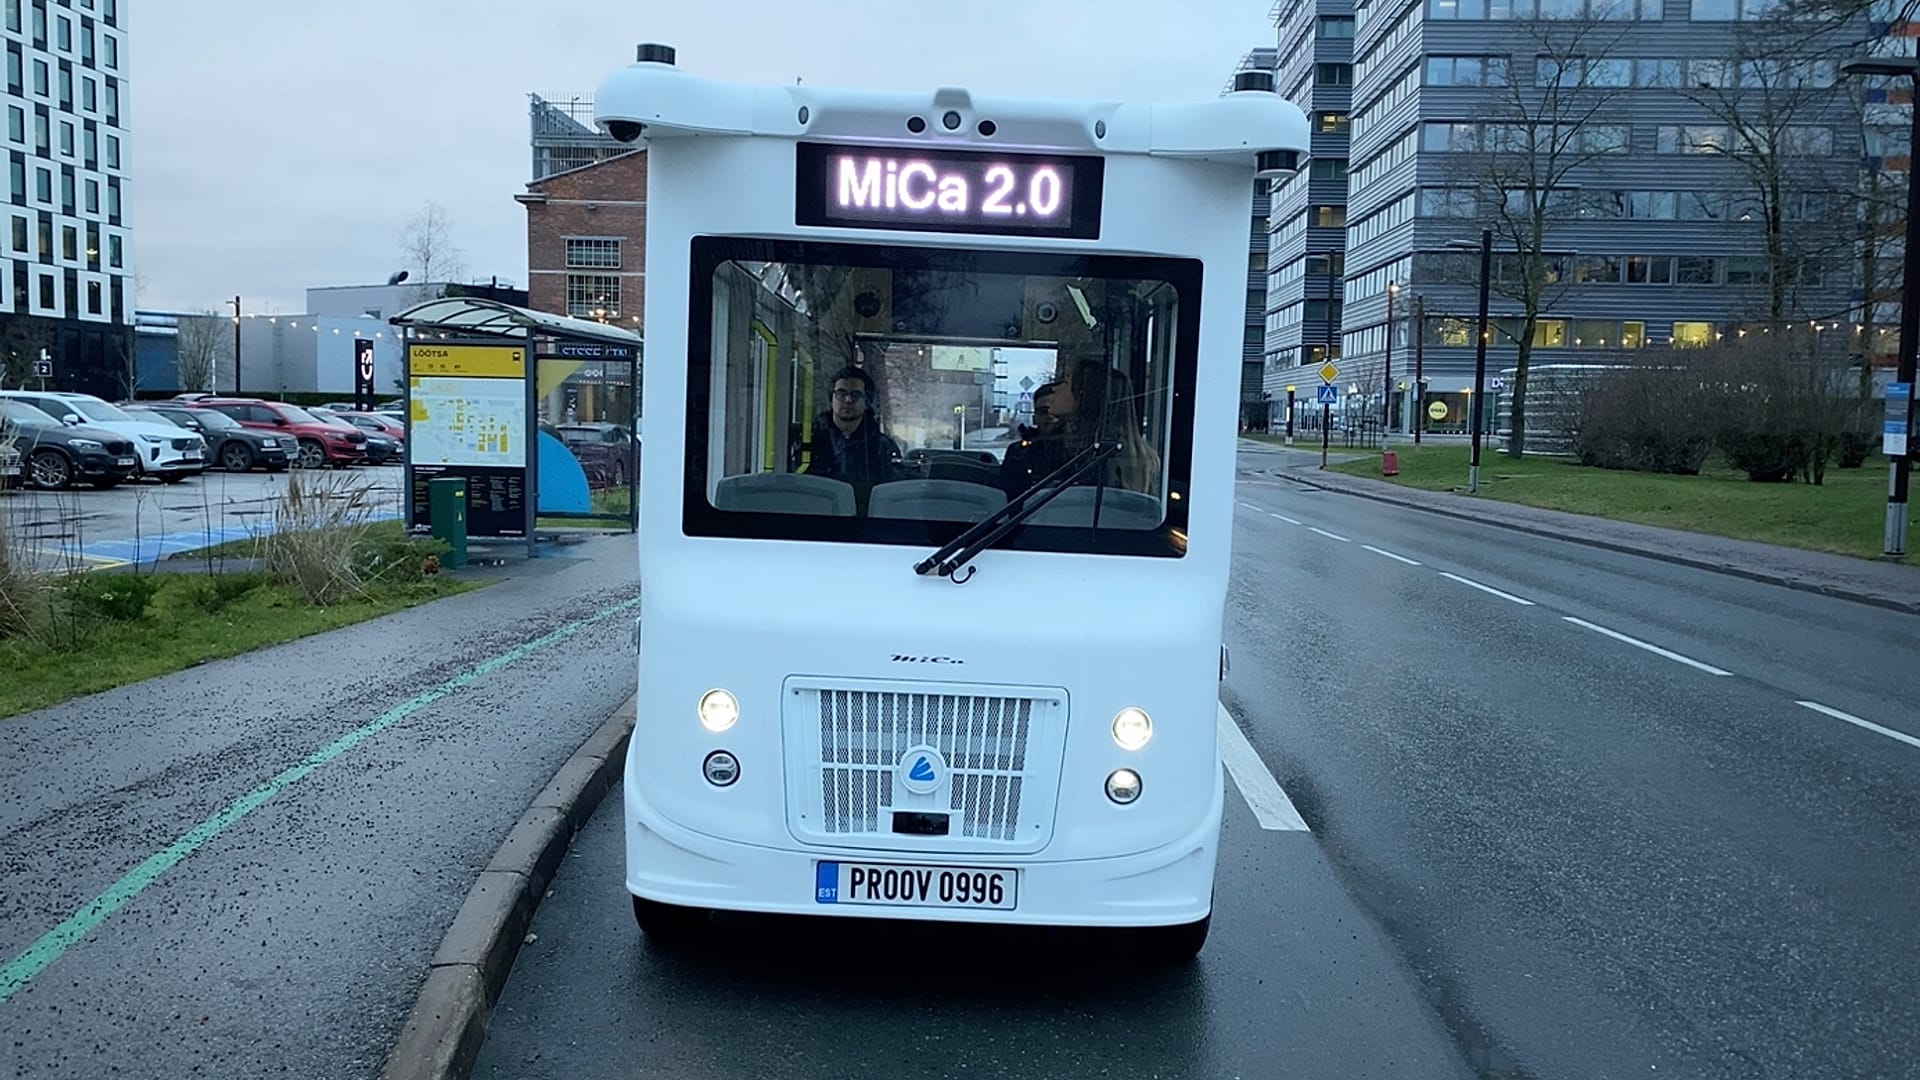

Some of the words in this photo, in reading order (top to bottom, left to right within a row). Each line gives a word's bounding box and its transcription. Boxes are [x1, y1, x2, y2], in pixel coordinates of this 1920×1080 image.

[838, 157, 967, 212] MiCa
[981, 165, 1061, 216] 2.0
[818, 888, 837, 899] EST
[850, 867, 932, 902] PROOV
[939, 871, 1004, 905] 0996
